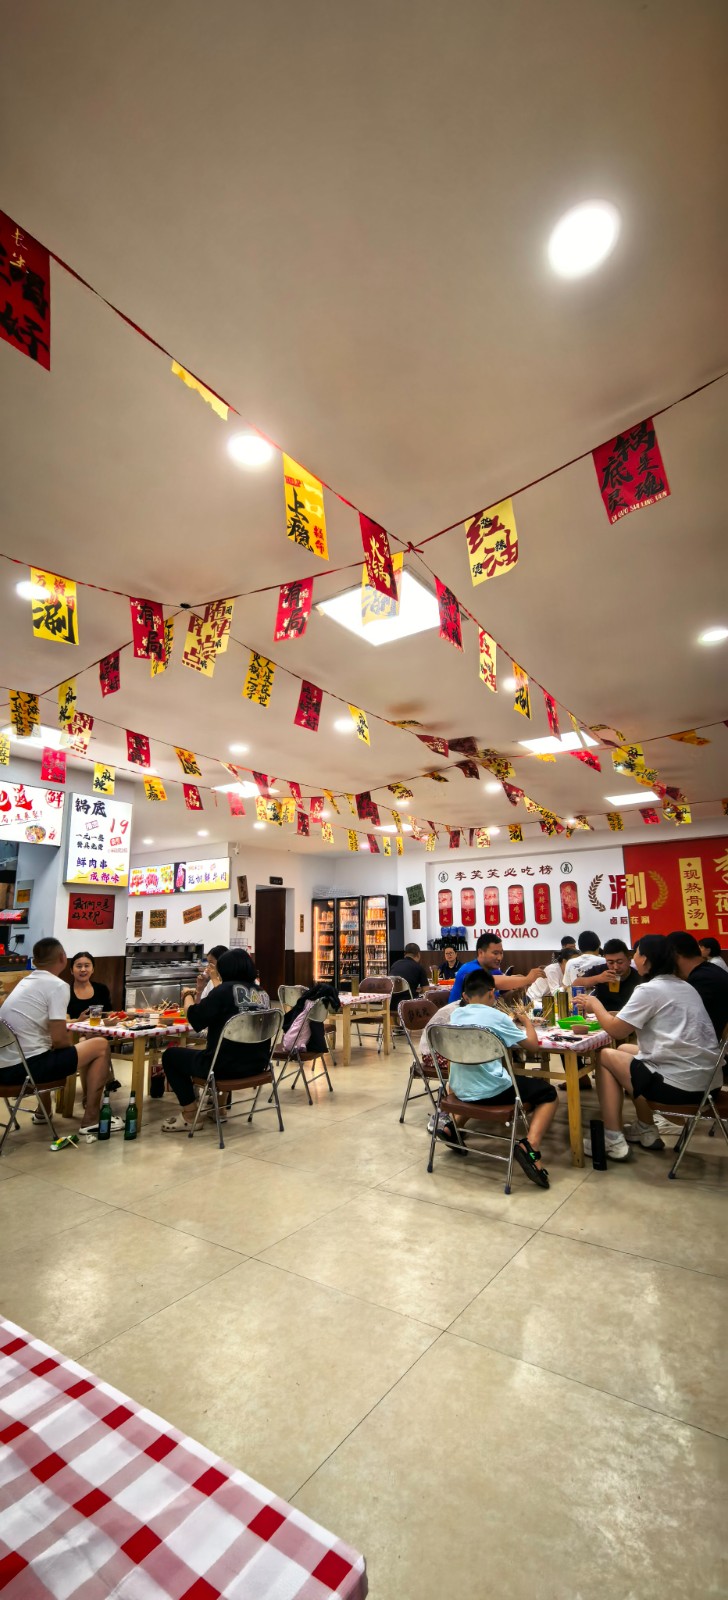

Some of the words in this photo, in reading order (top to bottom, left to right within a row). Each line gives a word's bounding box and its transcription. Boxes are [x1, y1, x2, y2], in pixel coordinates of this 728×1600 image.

[466, 512, 518, 577] 红油
[370, 535, 390, 589] 火锅
[284, 581, 306, 634] 有局
[75, 797, 107, 817] 锅底
[110, 818, 128, 834] 19
[76, 857, 107, 869] 鲜肉串
[454, 865, 553, 881] 李笑笑必吃榜
[90, 871, 120, 883] 成都味
[683, 870, 705, 919] 现熬骨汤
